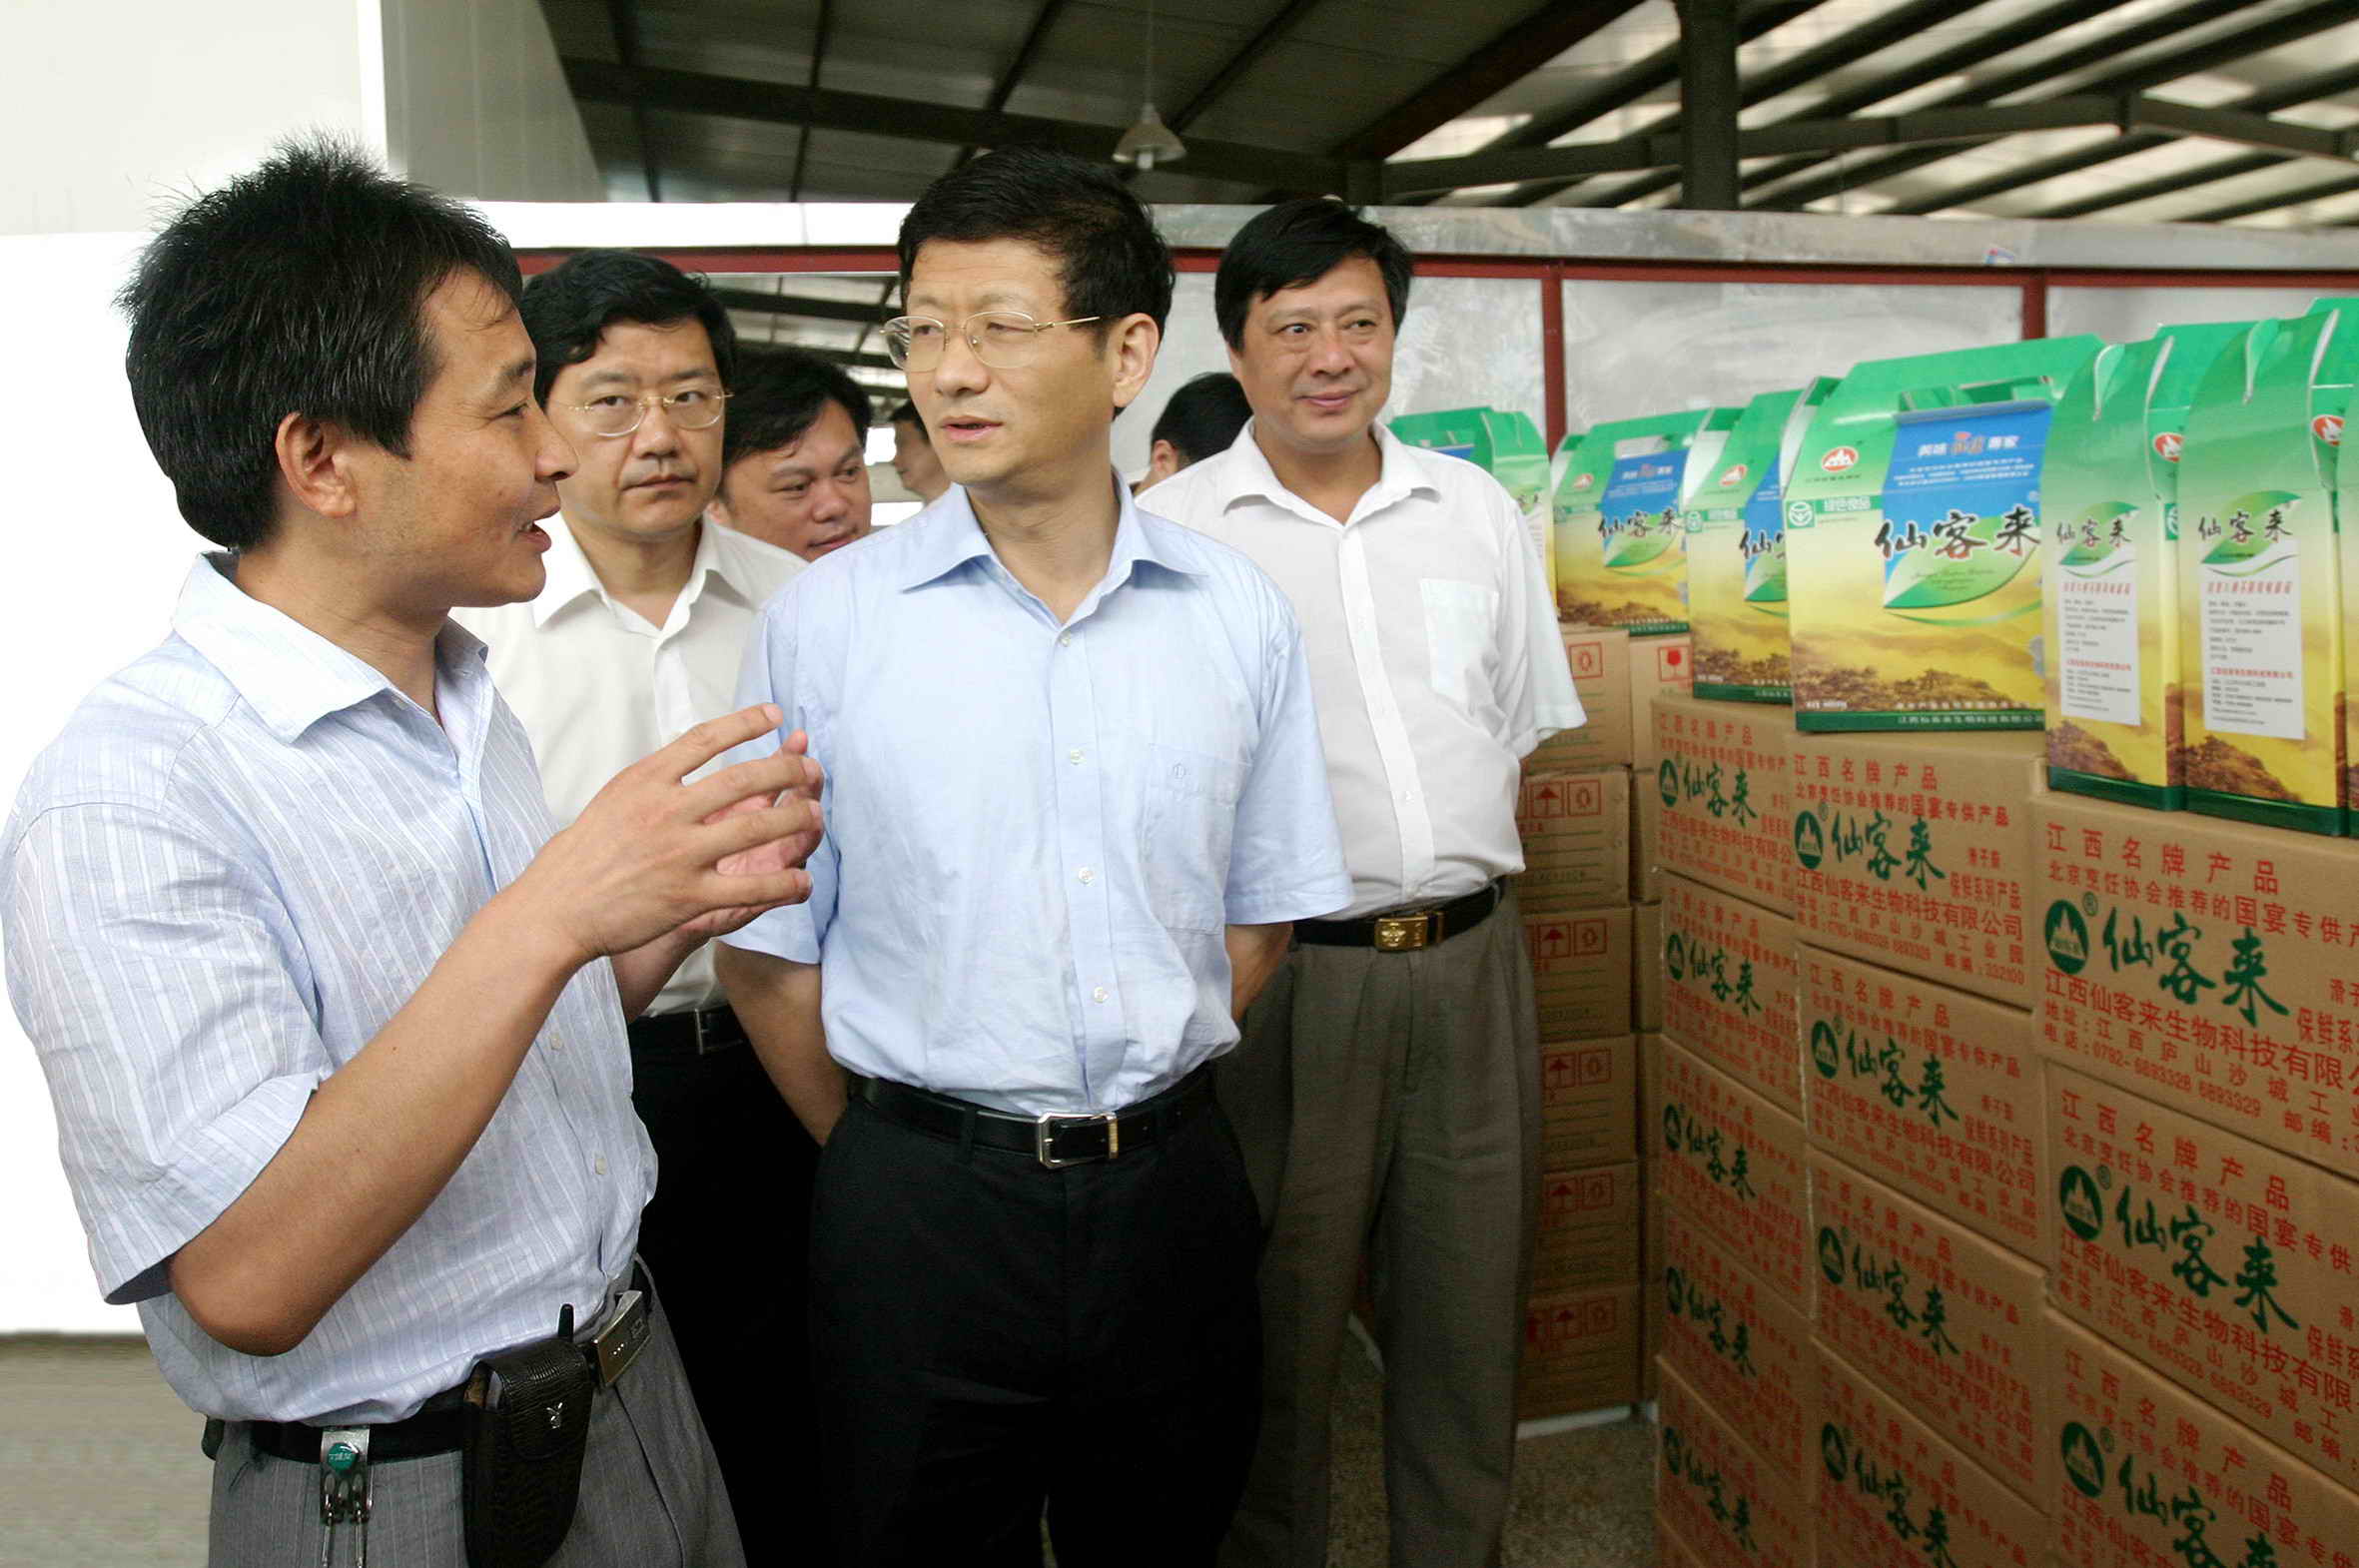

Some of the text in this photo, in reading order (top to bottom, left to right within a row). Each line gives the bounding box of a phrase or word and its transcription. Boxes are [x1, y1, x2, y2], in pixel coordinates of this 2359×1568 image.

[1875, 505, 2041, 559] 仙客来
[2056, 518, 2132, 548] 仙客来
[2198, 508, 2293, 543] 仙客来
[1684, 761, 1758, 827] 仙客来
[1794, 753, 1939, 790] 江西名牌产品
[1832, 809, 1946, 891] 仙客来
[2046, 822, 2281, 895] 江西名牌产品
[1796, 867, 2022, 941] 江西仙客来生物科技有限公司
[1690, 940, 1762, 1015] 仙客来
[2103, 906, 2289, 1027] 仙客来
[2296, 1007, 2359, 1056] 保鲜系
[1847, 1030, 1959, 1127] 仙客来
[2062, 1089, 2290, 1211] 江西名牌产品
[2116, 1185, 2300, 1333] 仙客来
[1853, 1243, 1960, 1355] 仙客来
[2063, 1349, 2291, 1511] 江西名牌产品
